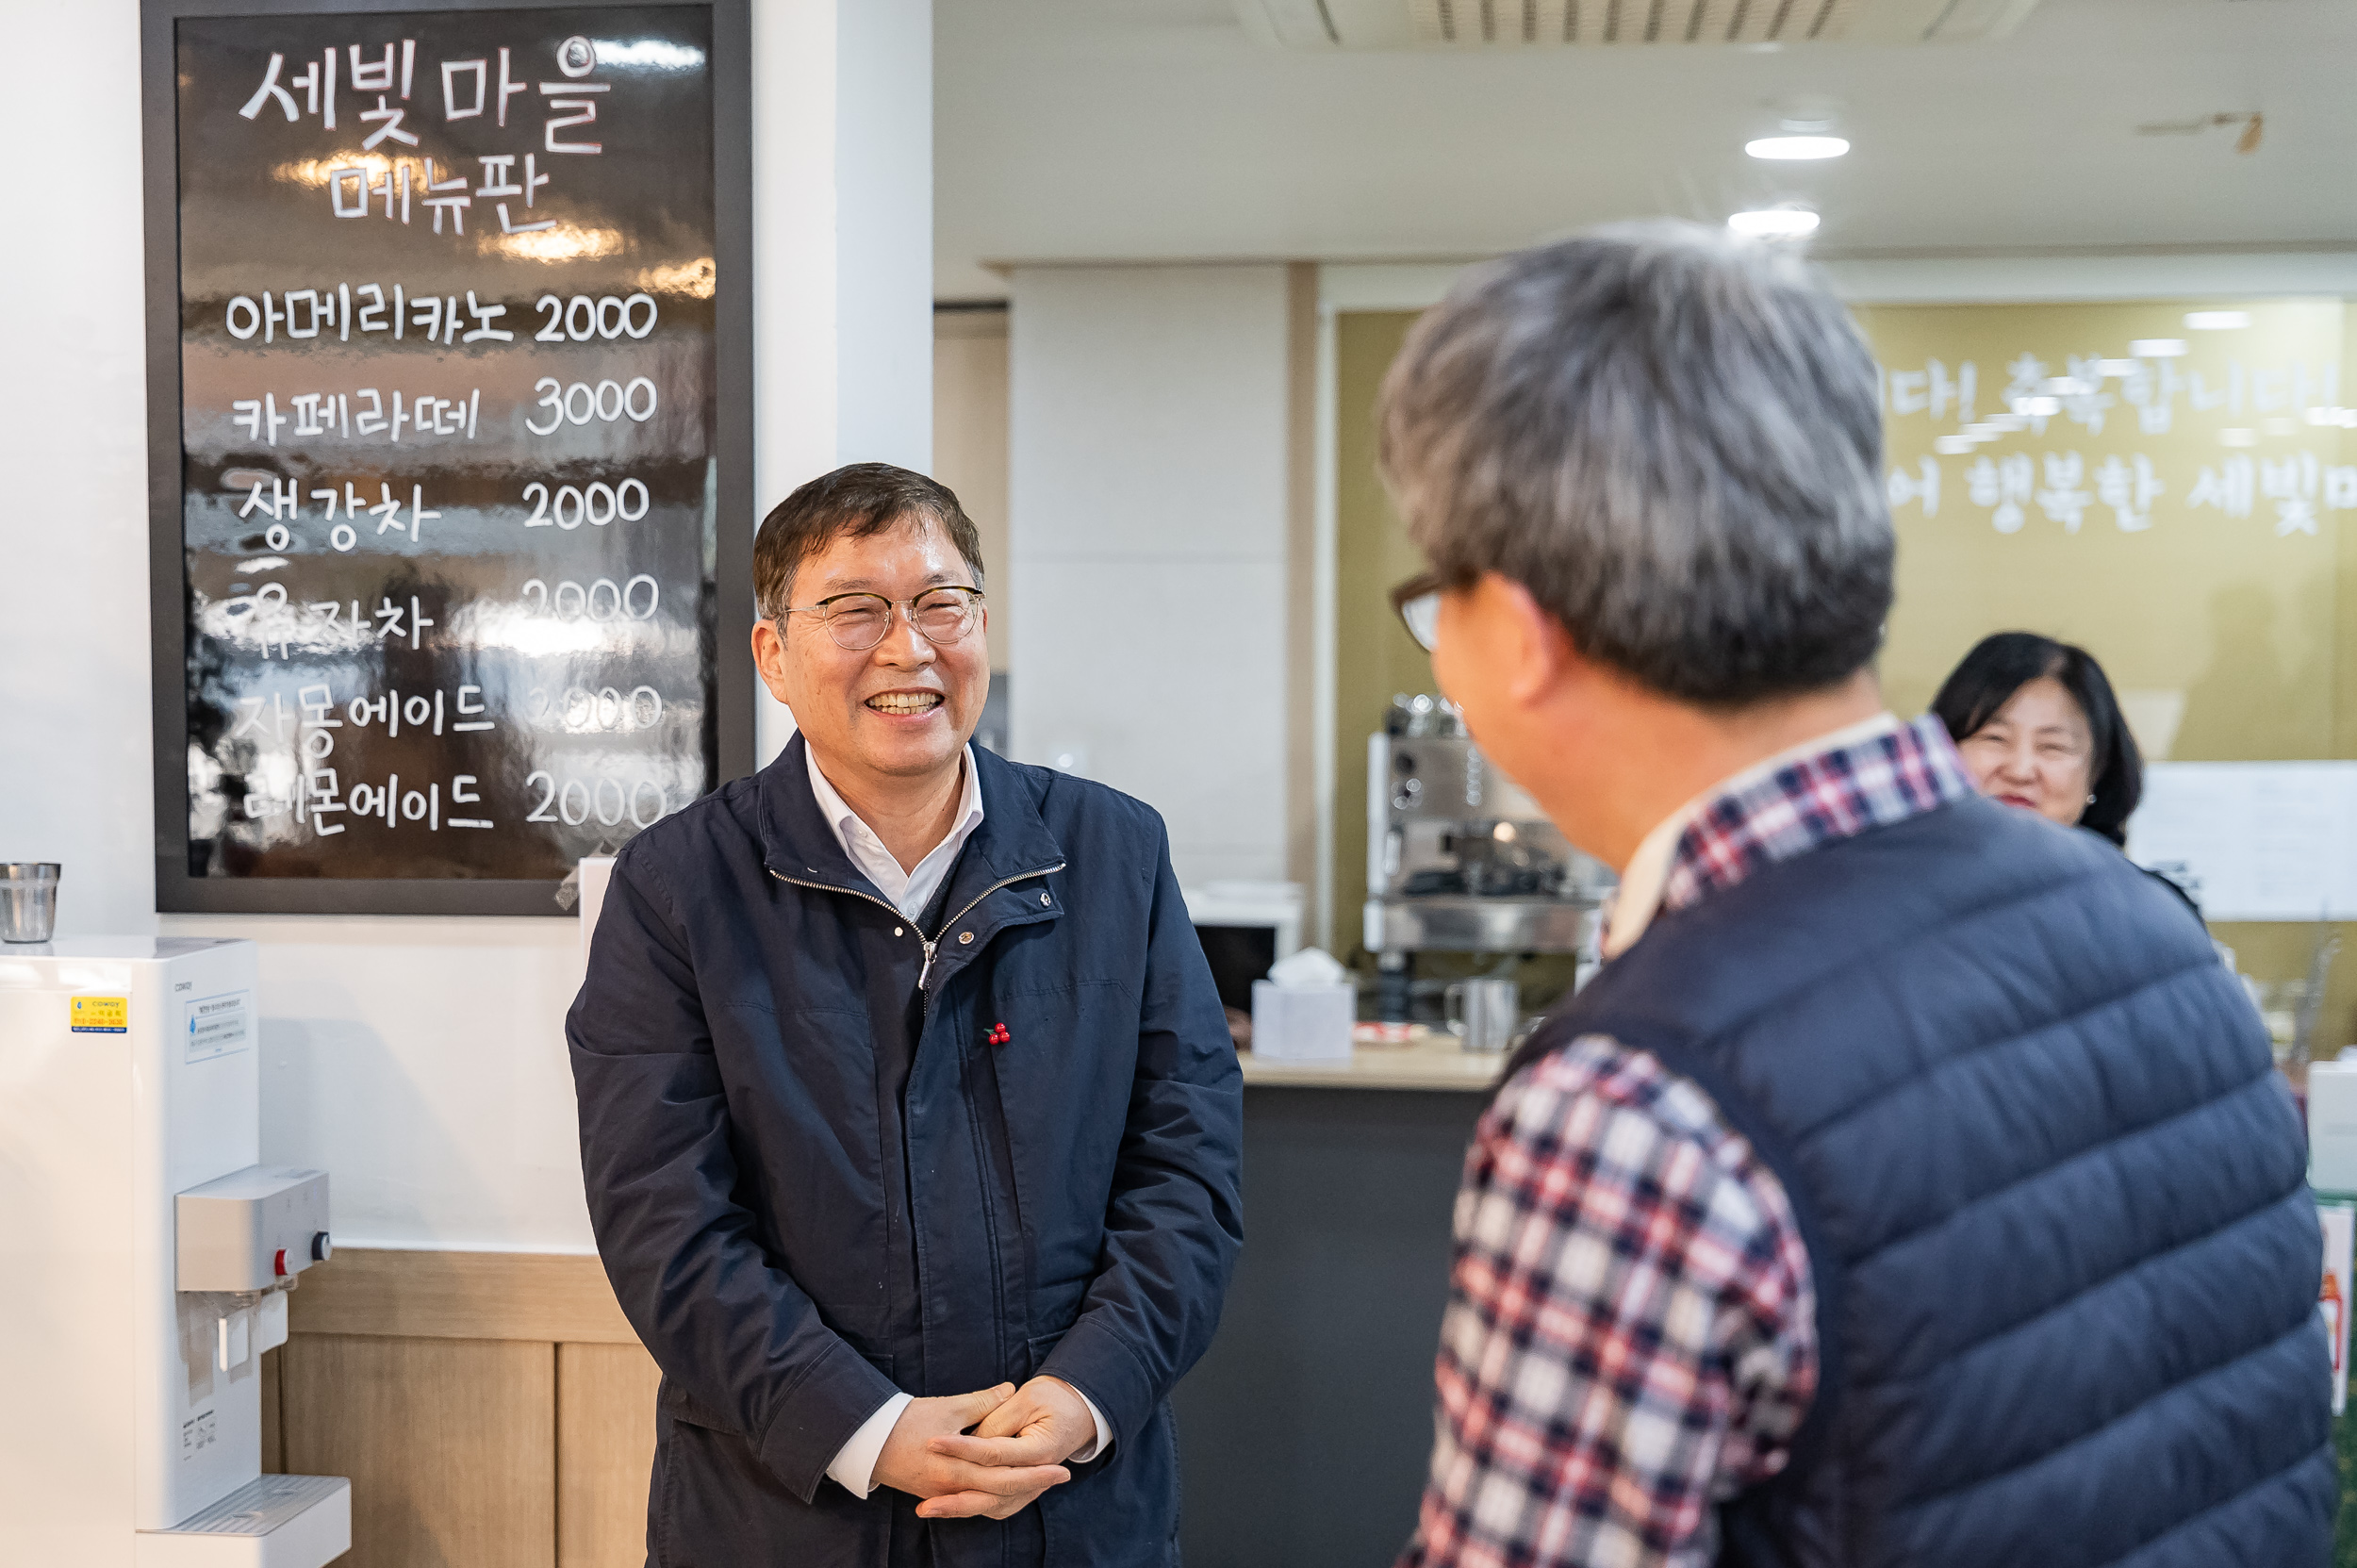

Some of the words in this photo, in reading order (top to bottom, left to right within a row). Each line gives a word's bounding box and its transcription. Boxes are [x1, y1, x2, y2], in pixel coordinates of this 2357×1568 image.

[330, 153, 557, 236] 메뉴판
[225, 282, 515, 343] 아메리카노
[534, 293, 659, 342] 2000
[232, 388, 481, 446] 카페라떼
[524, 376, 658, 437] 3000
[1876, 356, 1978, 423] 다!
[238, 477, 442, 552] 생강차
[521, 477, 650, 531] 2000
[1964, 449, 2167, 536] 행복한
[256, 581, 435, 661] 유자차
[521, 573, 660, 623] 2000
[235, 683, 496, 760] 자몽에이드
[243, 767, 495, 837] 레몬에이드
[525, 769, 668, 830] 2000
